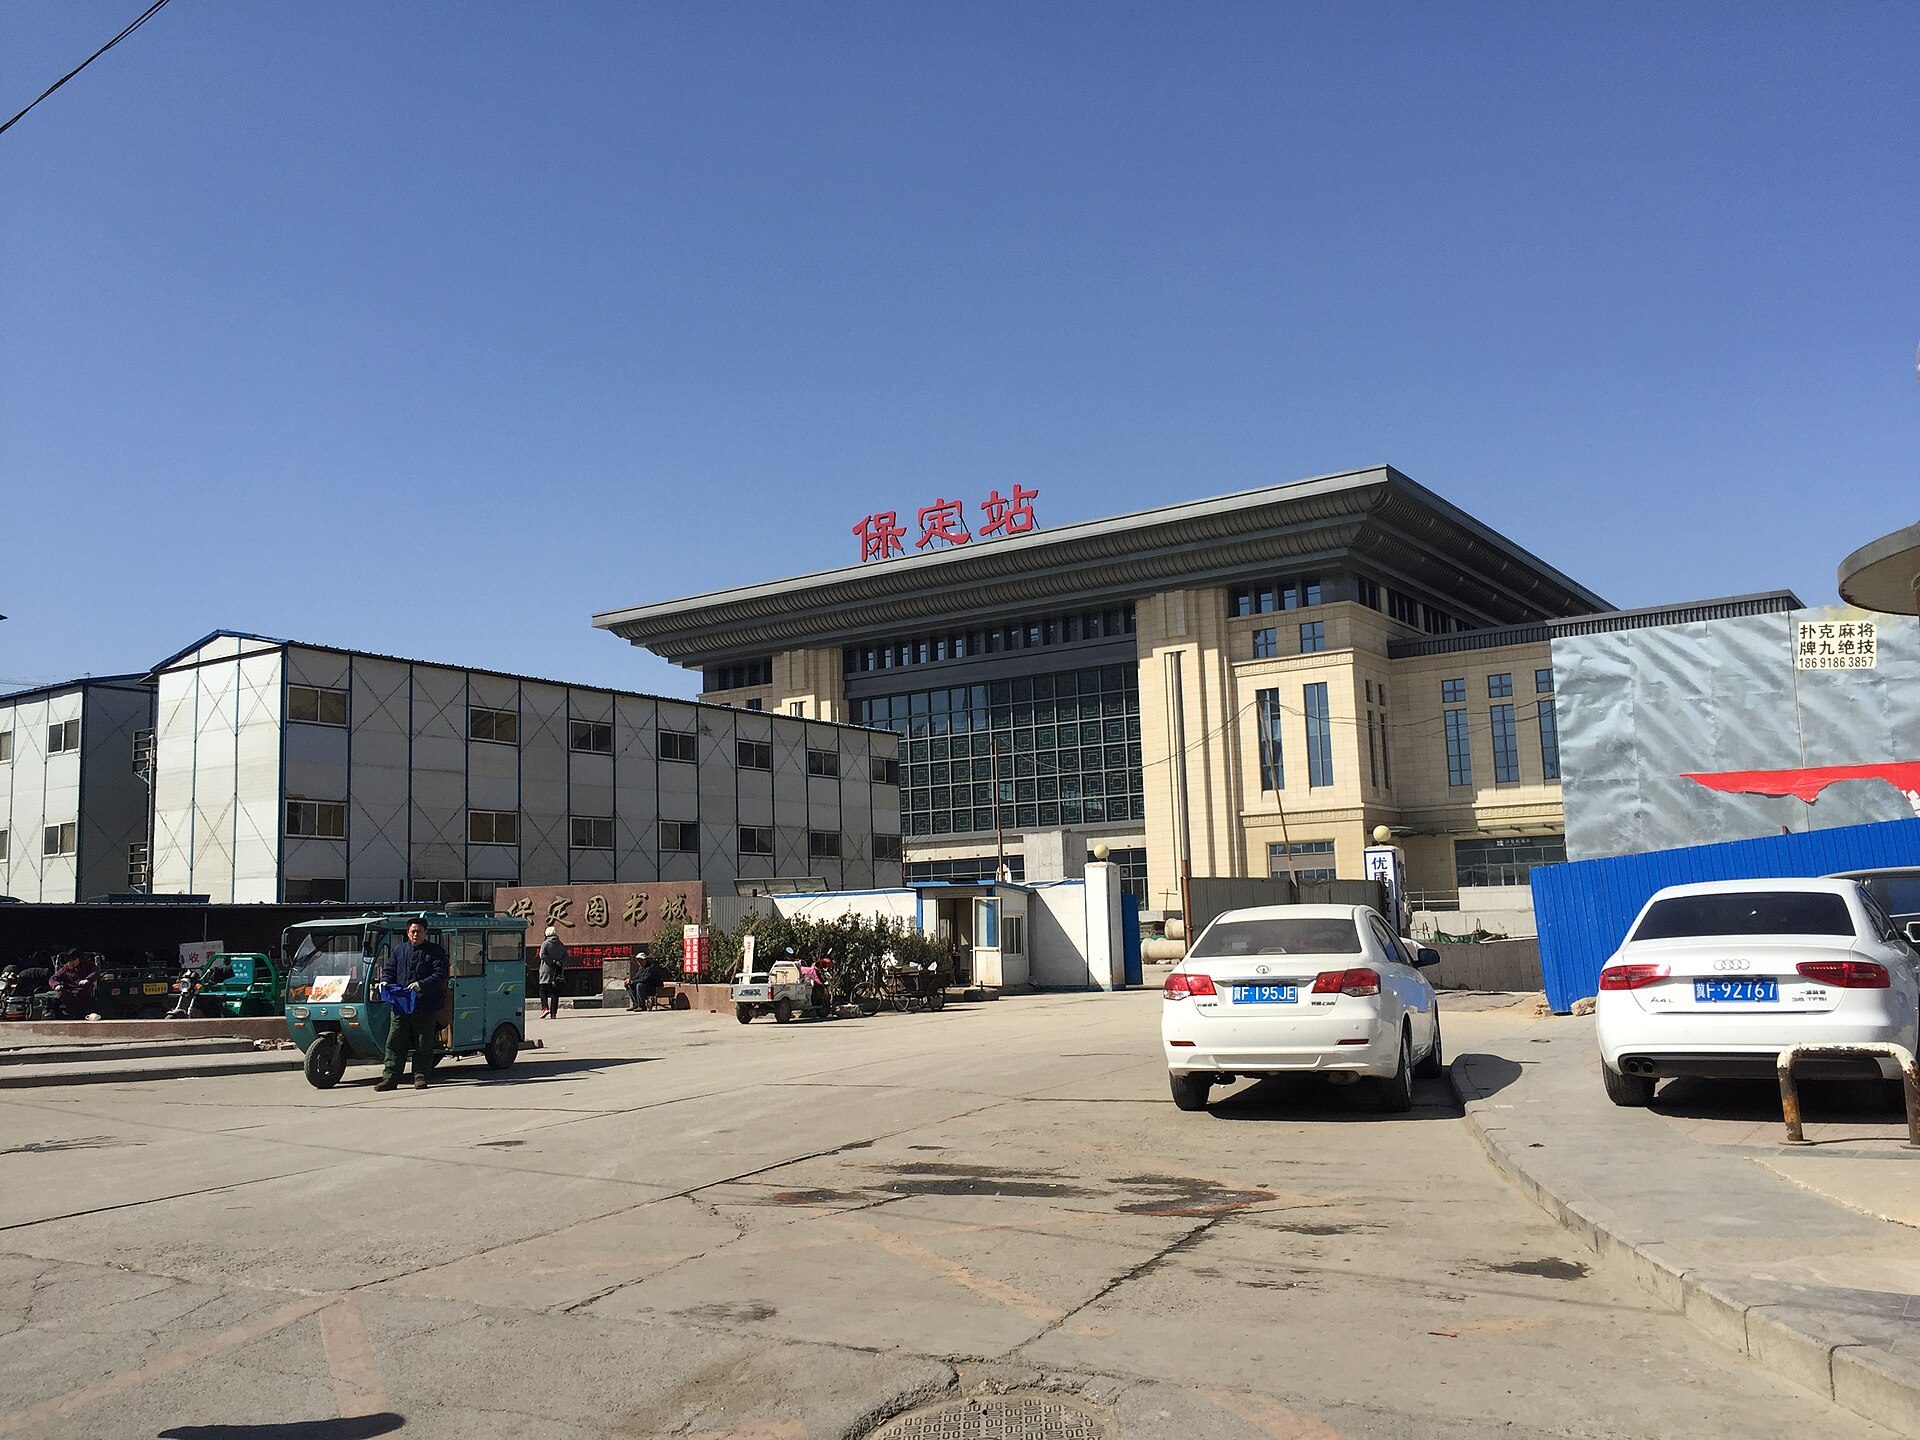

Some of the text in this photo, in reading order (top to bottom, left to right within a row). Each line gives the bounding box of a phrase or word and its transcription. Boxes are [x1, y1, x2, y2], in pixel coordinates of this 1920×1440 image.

[852, 483, 1039, 562] 保定站
[1799, 622, 1875, 639] 扑克麻将
[1799, 639, 1875, 655] 牌九绝技
[1799, 656, 1874, 669] 186 9186 3857
